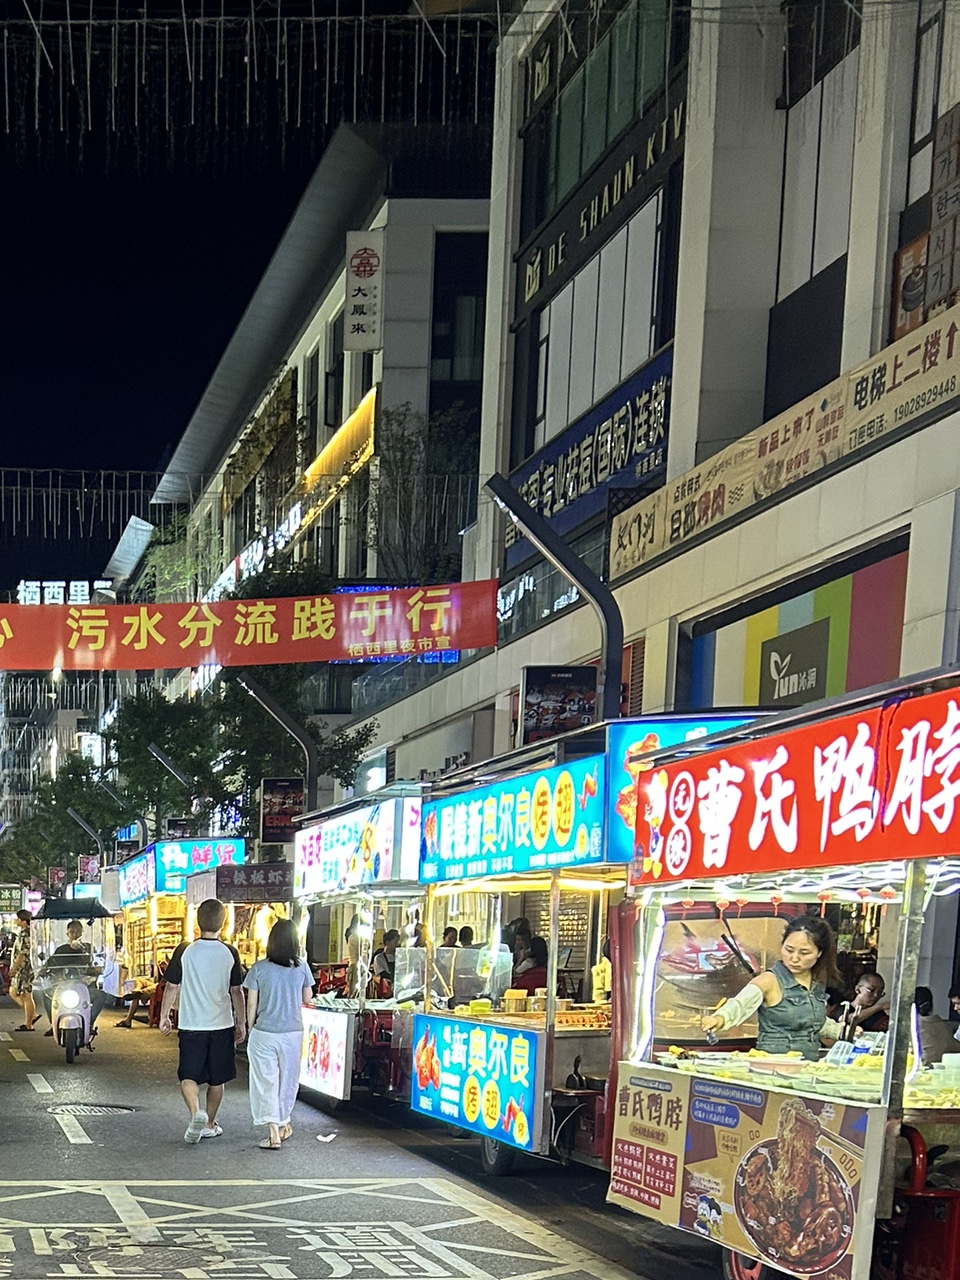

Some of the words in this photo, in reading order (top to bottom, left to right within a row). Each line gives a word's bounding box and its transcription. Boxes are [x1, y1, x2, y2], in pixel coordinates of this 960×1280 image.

[548, 232, 566, 277] DE
[853, 328, 942, 411] 电梯上二楼
[894, 375, 957, 423] 19028929448
[66, 587, 452, 652] 污水分流践于行
[347, 636, 452, 658] 栖西里夜市宣
[697, 699, 960, 869] 曹氏鸭脖
[619, 1085, 683, 1131] 曹氏鸭脖
